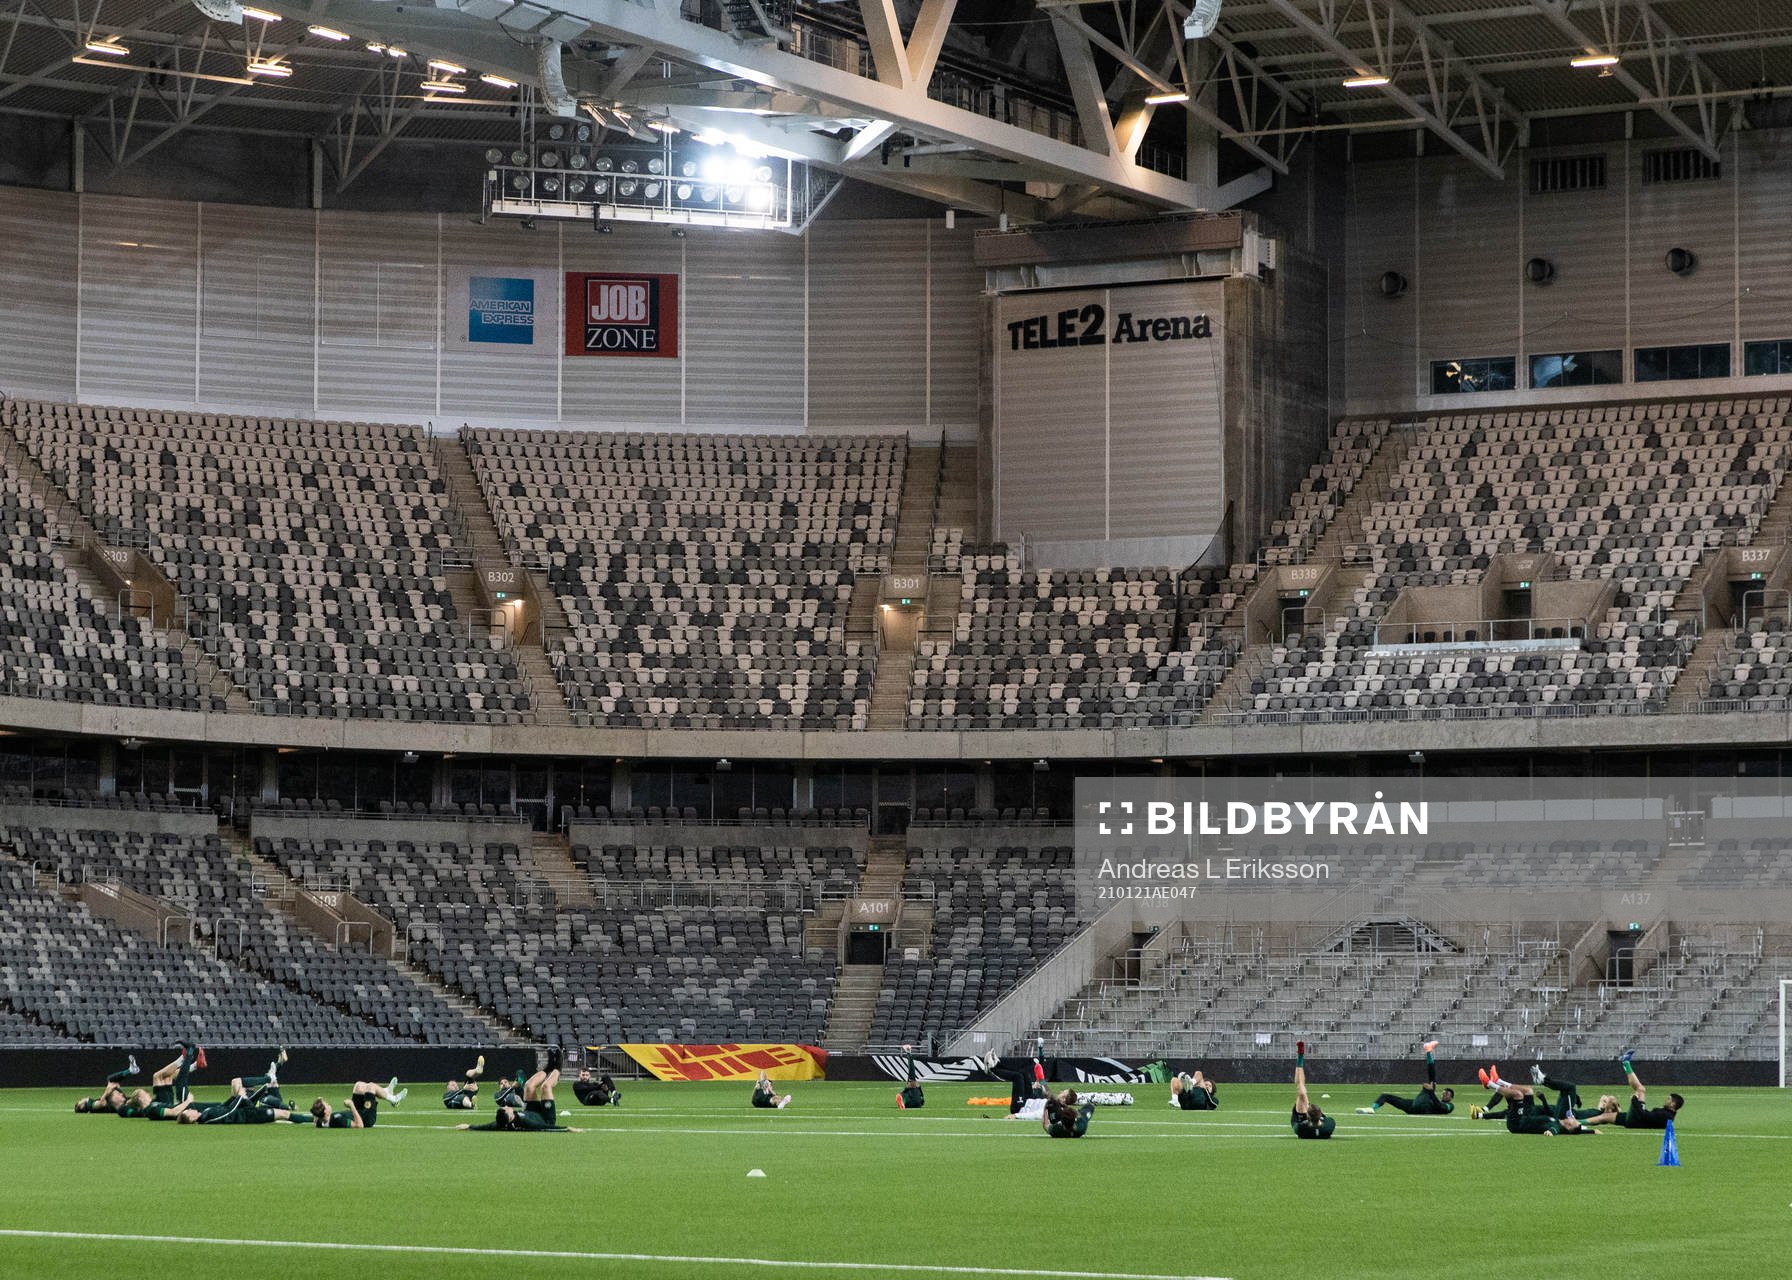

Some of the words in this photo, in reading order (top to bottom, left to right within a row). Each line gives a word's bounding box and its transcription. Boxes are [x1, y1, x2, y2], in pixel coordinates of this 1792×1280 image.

[470, 300, 530, 312] AMERICAN
[591, 285, 646, 321] JOB
[483, 313, 534, 325] EXPRESS
[1008, 304, 1105, 350] TELE2
[1112, 313, 1212, 343] Arena
[586, 328, 657, 349] ZONE
[1742, 549, 1770, 561] B337
[488, 571, 514, 582] B302
[1291, 568, 1318, 580] B338
[894, 578, 919, 589] B301
[1621, 893, 1651, 905] A137
[860, 903, 889, 913] A101
